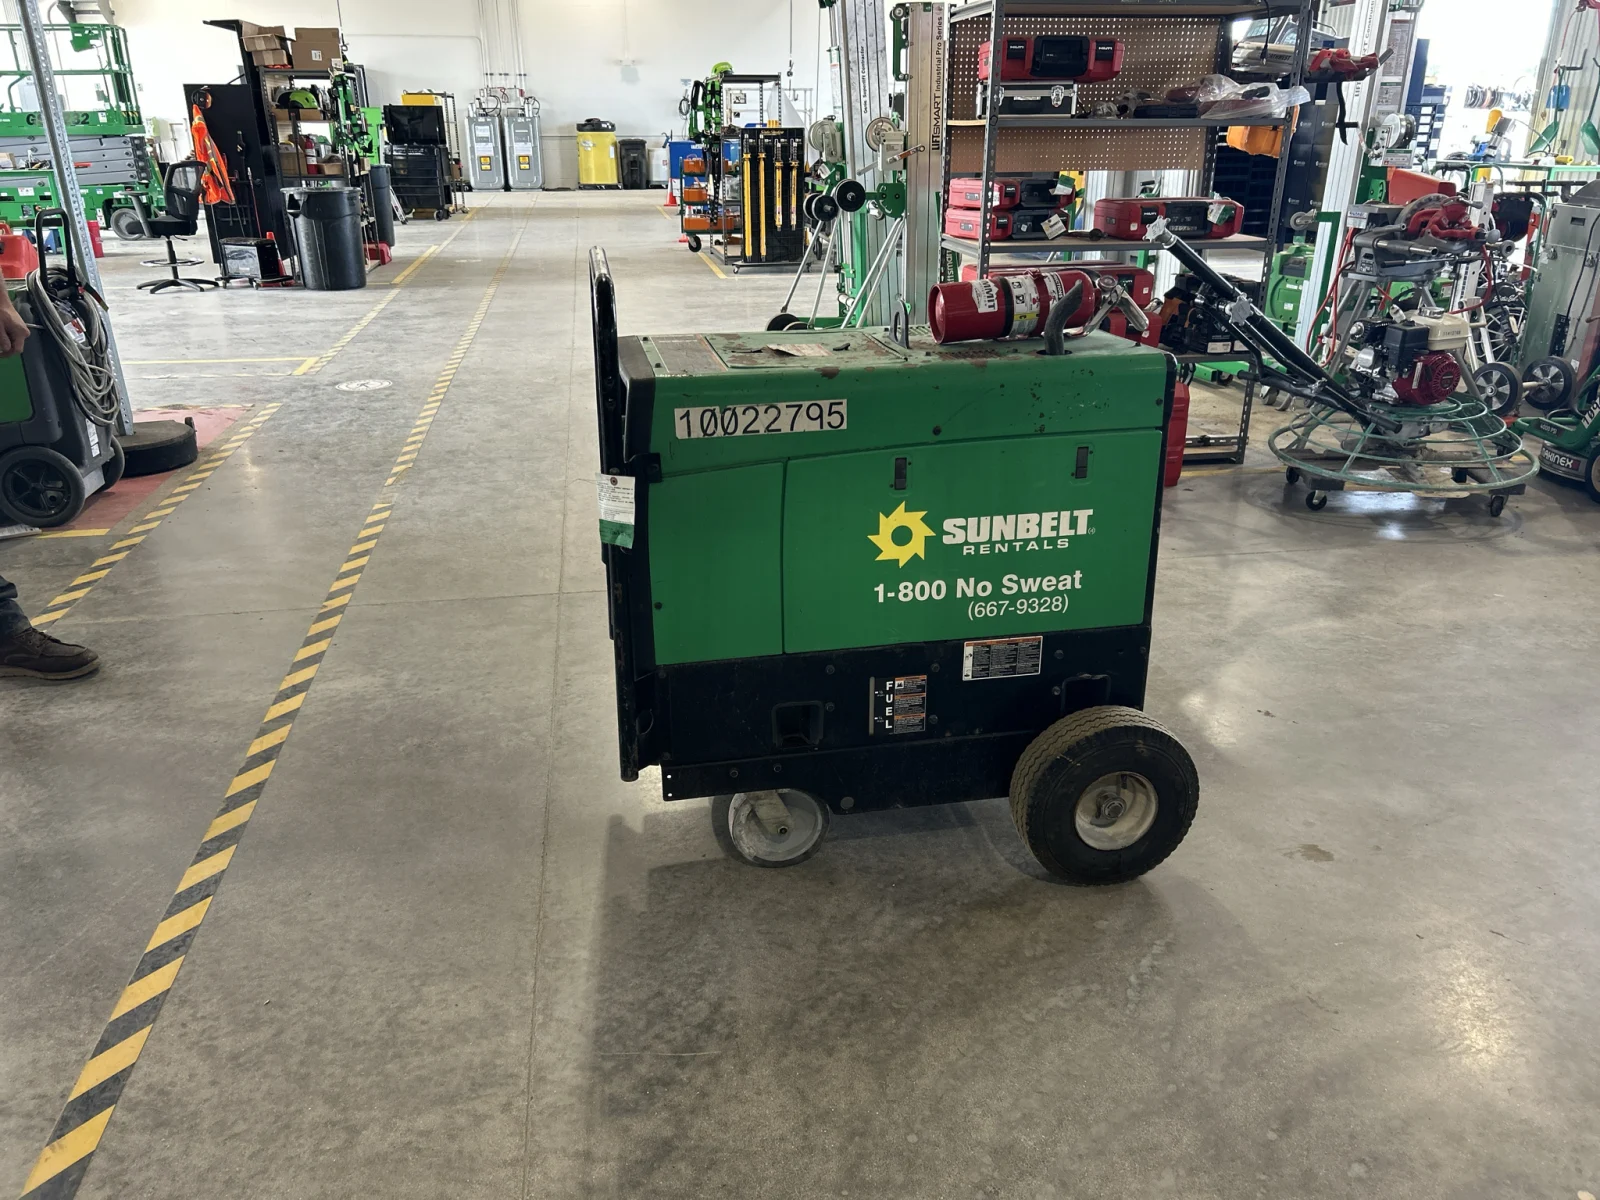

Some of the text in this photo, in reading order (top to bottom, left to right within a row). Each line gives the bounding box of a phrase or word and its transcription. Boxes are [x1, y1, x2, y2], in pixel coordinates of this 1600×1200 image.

[935, 16, 943, 40] Series
[679, 401, 845, 438] 10022795
[942, 508, 1094, 545] SUNBELT
[963, 538, 1069, 556] RENTALS
[874, 570, 1083, 603] 1-800 No Sweat
[968, 594, 1069, 621] (667-9328)
[885, 681, 894, 729] FUEL
